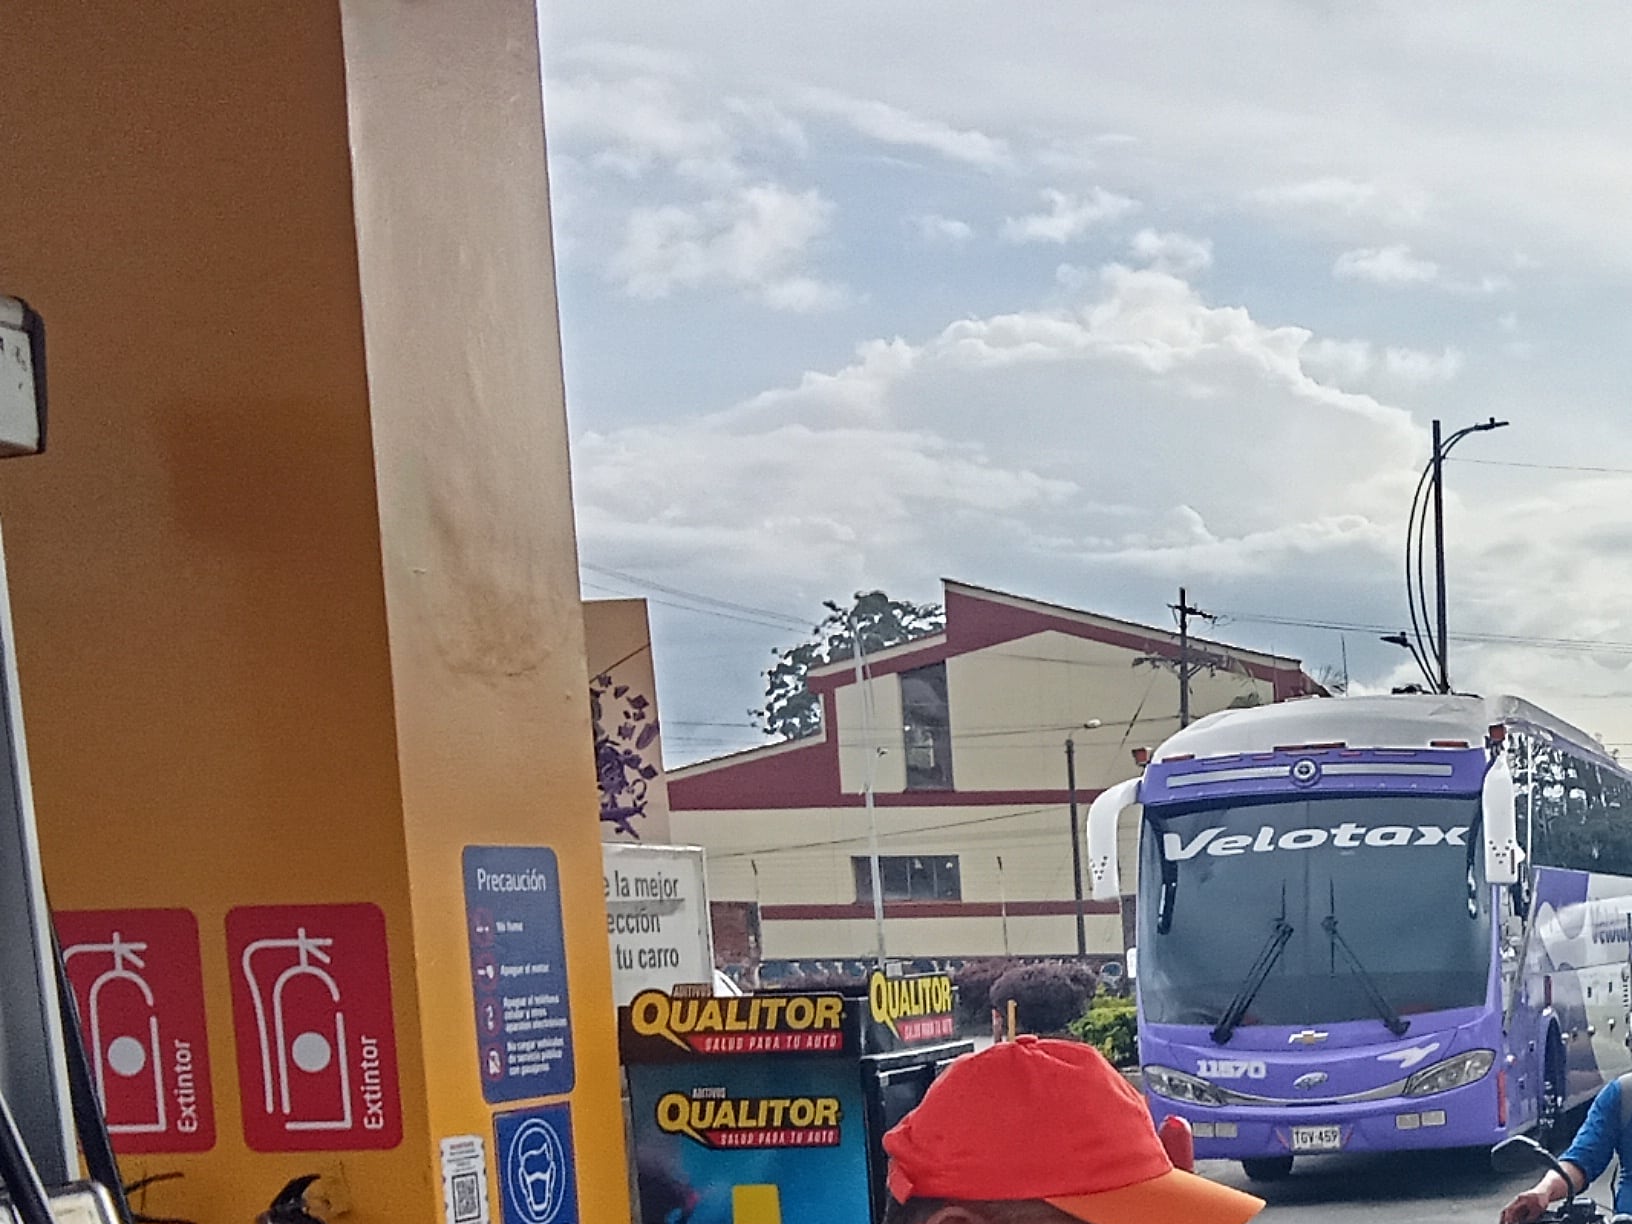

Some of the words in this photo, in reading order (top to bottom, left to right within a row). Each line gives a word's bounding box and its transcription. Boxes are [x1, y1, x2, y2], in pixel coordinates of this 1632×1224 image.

[1163, 823, 1470, 861] Velotax
[477, 867, 546, 892] Precaución
[615, 870, 630, 897] la
[634, 871, 678, 903] mejor
[617, 943, 633, 970] tu
[638, 947, 679, 969] carro
[632, 990, 843, 1052] QUALITOR
[871, 971, 951, 1039] QUALITOR
[705, 1037, 743, 1051] SALUD
[749, 1036, 780, 1050] PARA
[786, 1035, 801, 1049] TU
[807, 1034, 837, 1049] AUTO
[174, 1039, 198, 1133] Extintor
[361, 1035, 384, 1130] Extintor
[657, 1093, 839, 1144] QUALITOR
[721, 1133, 754, 1145] SALUD
[758, 1132, 785, 1144] PARA
[790, 1131, 803, 1144] TU
[807, 1131, 834, 1144] AUTO
